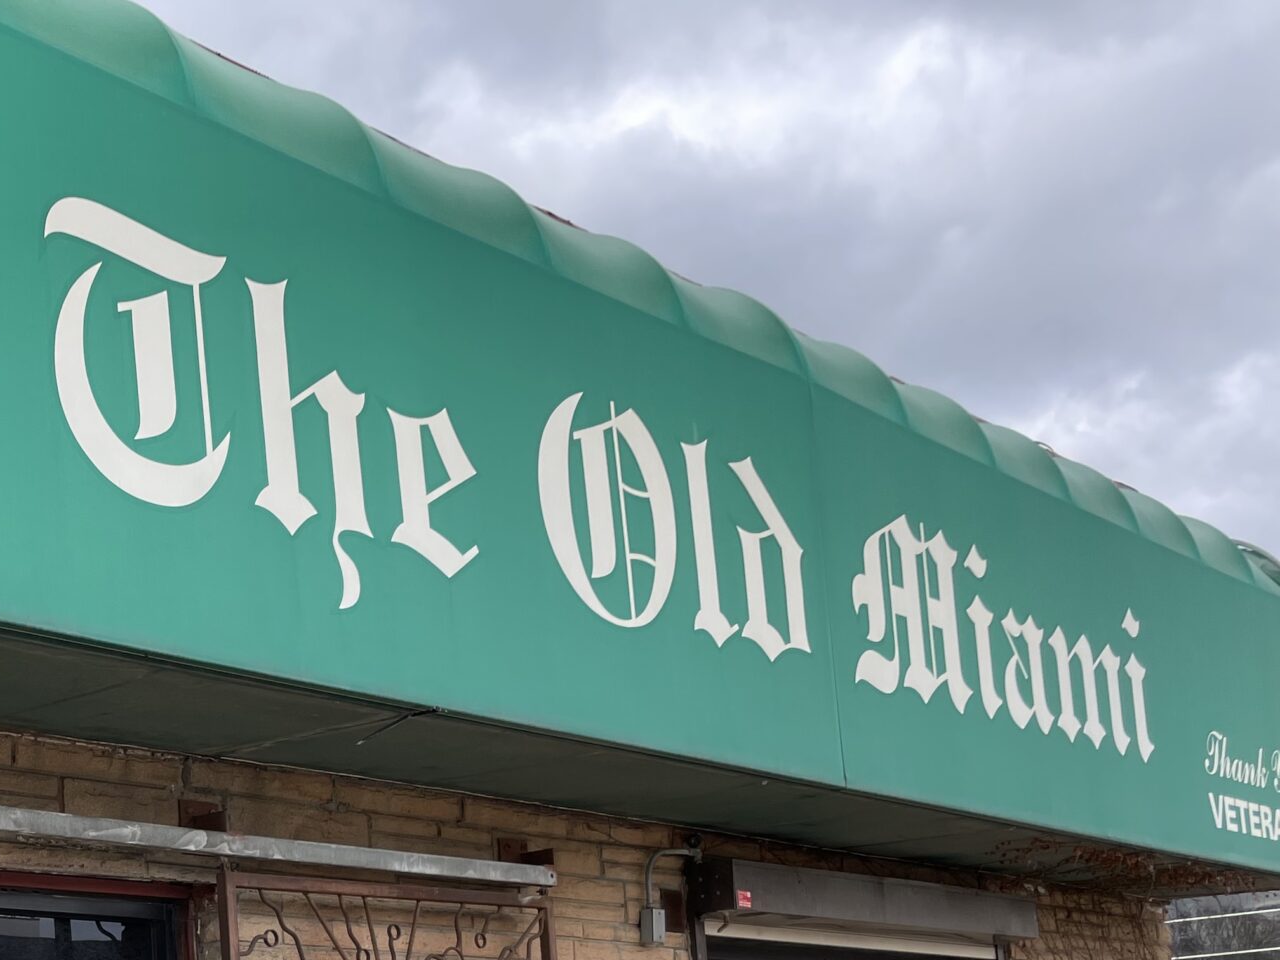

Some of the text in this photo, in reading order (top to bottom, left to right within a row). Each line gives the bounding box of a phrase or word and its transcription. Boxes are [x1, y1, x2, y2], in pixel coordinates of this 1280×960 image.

[43, 196, 1155, 763] The Old Miami
[1204, 730, 1269, 788] Thank
